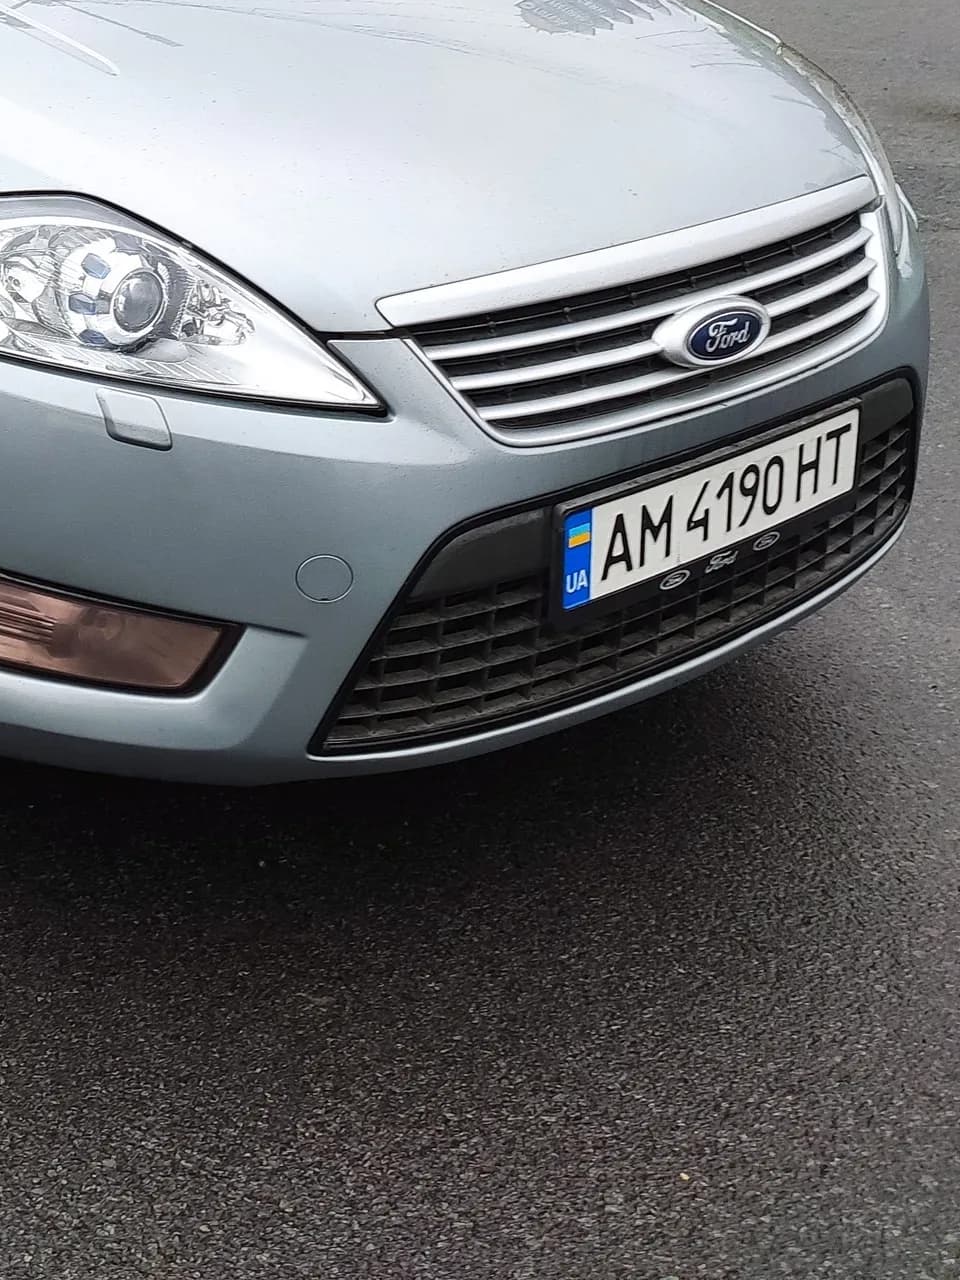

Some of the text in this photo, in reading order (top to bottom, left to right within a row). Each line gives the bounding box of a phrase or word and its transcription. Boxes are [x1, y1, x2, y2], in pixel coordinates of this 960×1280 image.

[705, 318, 750, 352] Ford
[566, 422, 852, 593] UA AM 4190 HT
